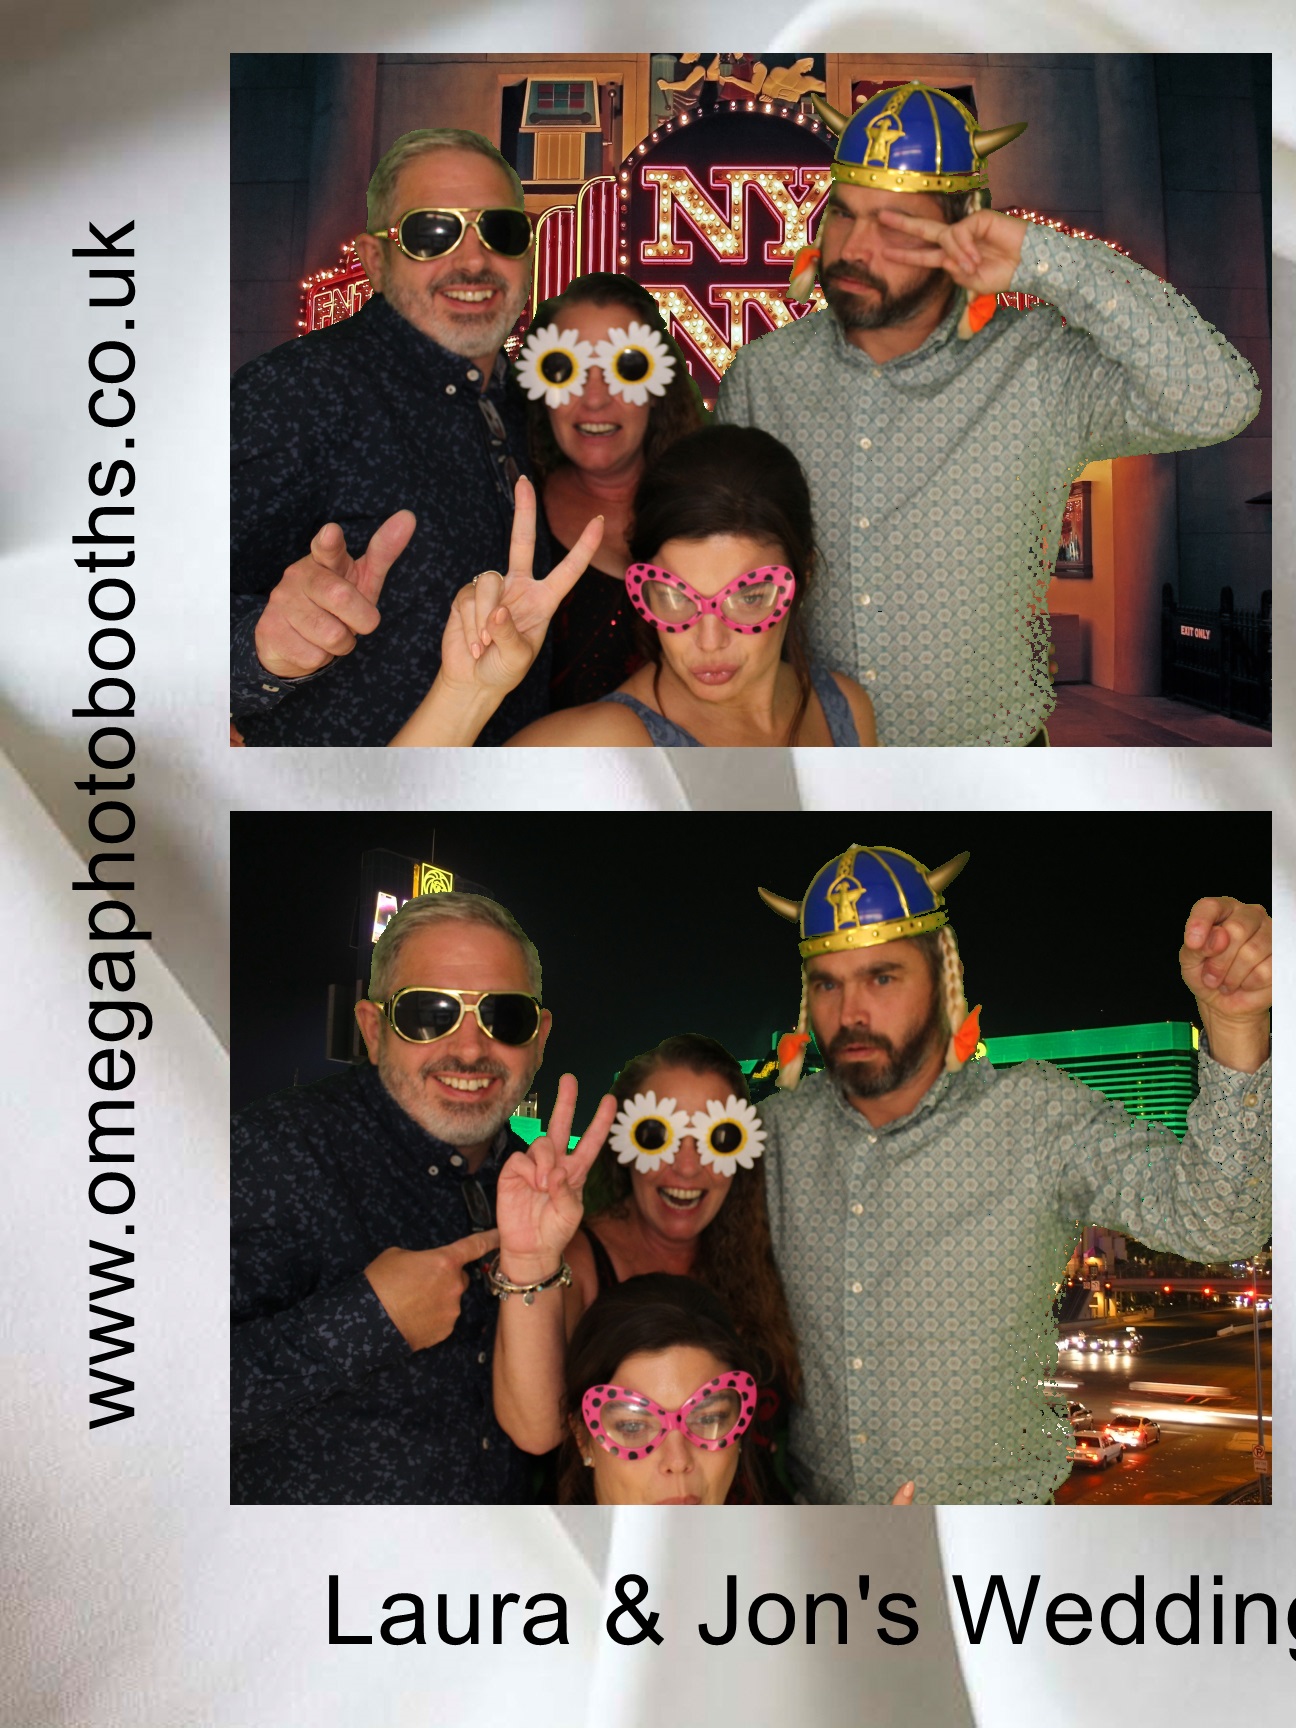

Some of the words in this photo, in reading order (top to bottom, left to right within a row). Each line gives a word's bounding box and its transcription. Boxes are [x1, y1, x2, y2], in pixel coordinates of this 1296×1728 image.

[641, 165, 832, 265] NY
[1181, 625, 1194, 637] EXIT
[1195, 627, 1210, 640] ONLY
